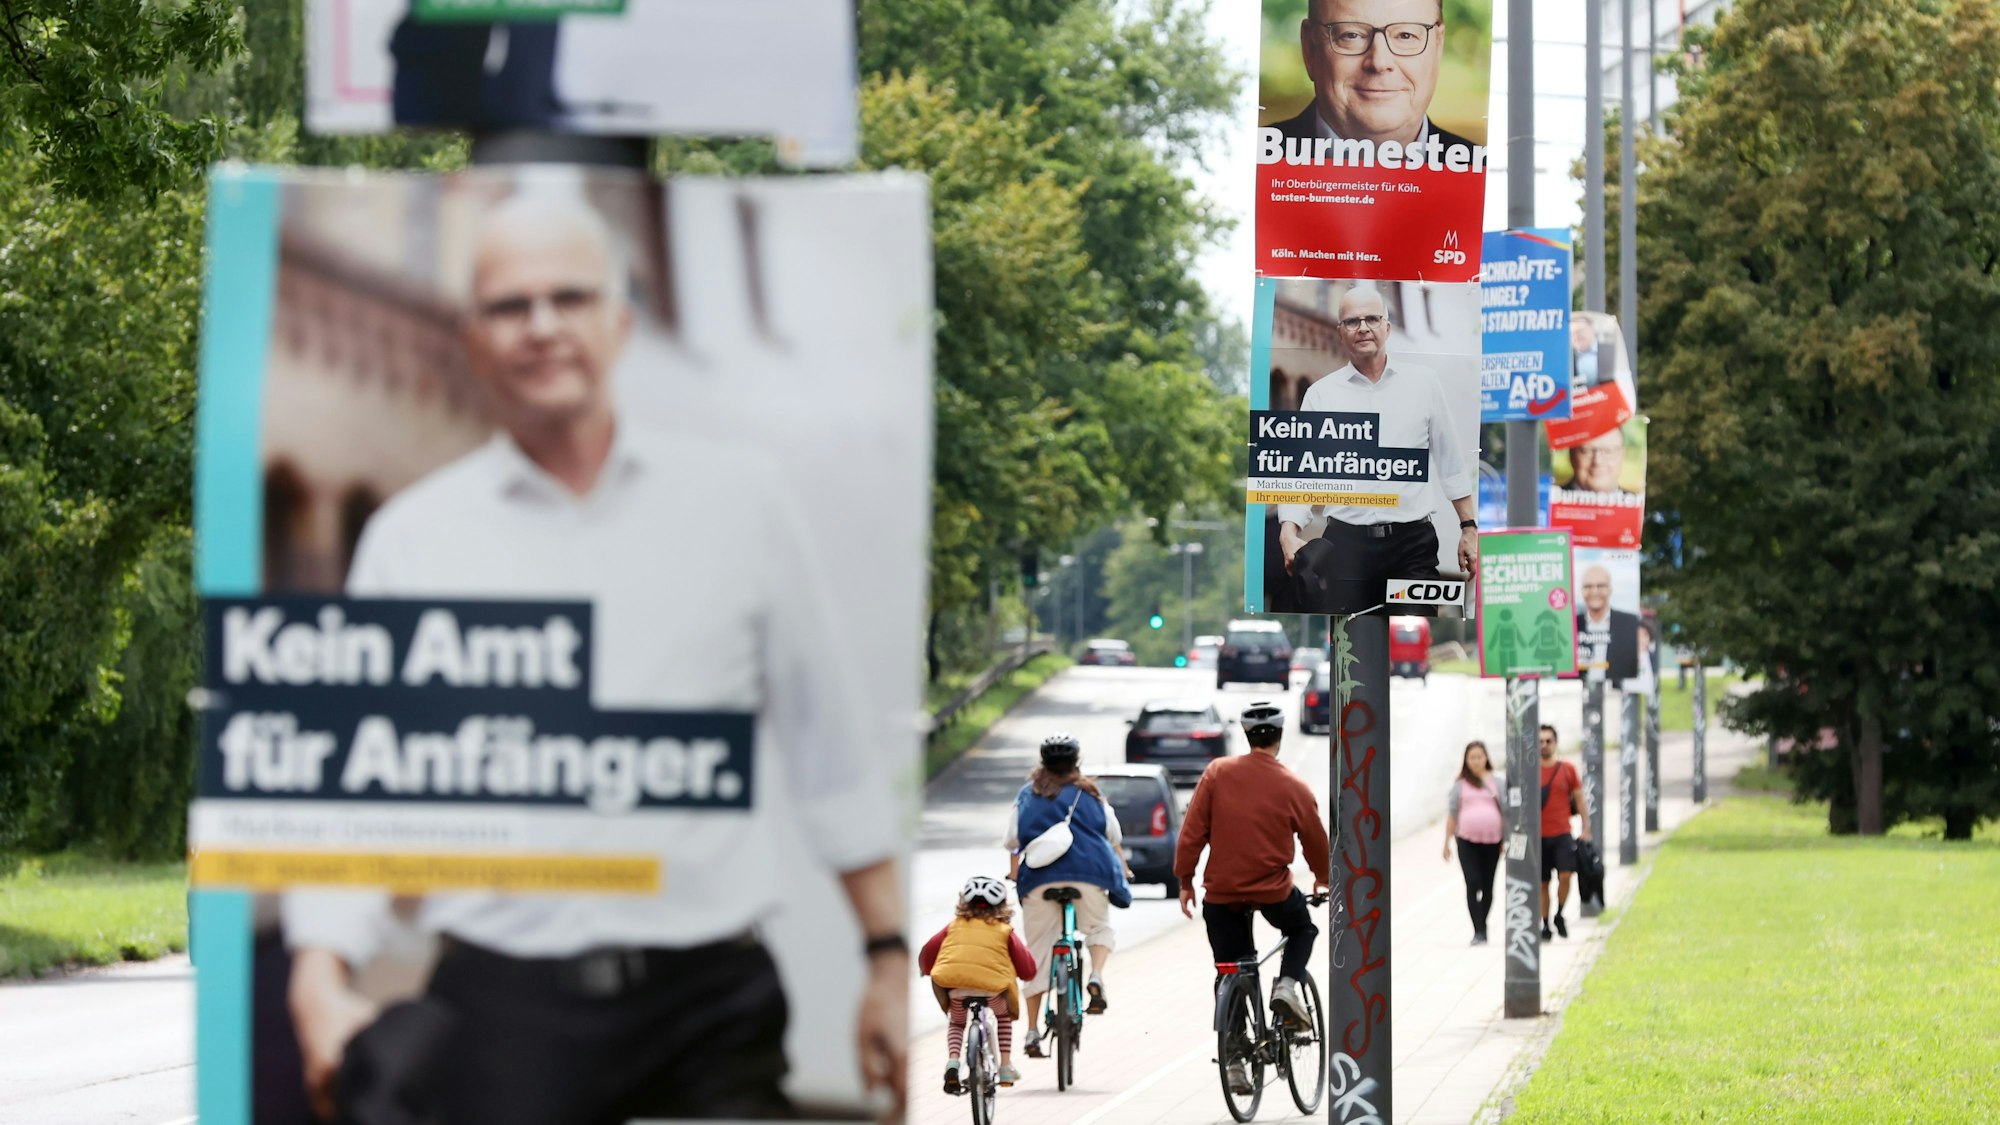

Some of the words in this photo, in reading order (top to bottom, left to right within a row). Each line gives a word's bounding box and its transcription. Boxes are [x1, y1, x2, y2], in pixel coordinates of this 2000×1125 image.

[1257, 127, 1487, 173] Burmester
[1271, 179, 1284, 188] Ihr
[1286, 179, 1379, 192] Oberbürgermeister
[1381, 182, 1396, 193] für
[1398, 183, 1421, 193] Köln.
[1271, 193, 1375, 205] torsten-burmester.de
[1271, 249, 1297, 259] Köln.
[1299, 249, 1335, 260] Machen
[1338, 250, 1353, 261] mit
[1355, 251, 1381, 262] Herz.
[1433, 249, 1466, 265] SPD
[1488, 309, 1564, 333] STADTRAT!
[1509, 373, 1556, 400] AfD
[1258, 416, 1312, 439] Kein
[1318, 418, 1373, 440] Amt
[1257, 450, 1294, 473] für
[1298, 451, 1423, 480] Anfänger.
[1256, 480, 1293, 490] Markus
[1295, 480, 1353, 491] Greitemann
[1256, 493, 1270, 502] Ihr
[1273, 494, 1300, 503] neuer
[1302, 493, 1397, 506] Oberbürgermeister
[1482, 563, 1564, 583] SCHULEN
[1407, 584, 1461, 601] CDU
[222, 606, 393, 686] Kein
[401, 610, 583, 690] Amt
[219, 712, 336, 792] für
[341, 715, 742, 815] Anfänger.
